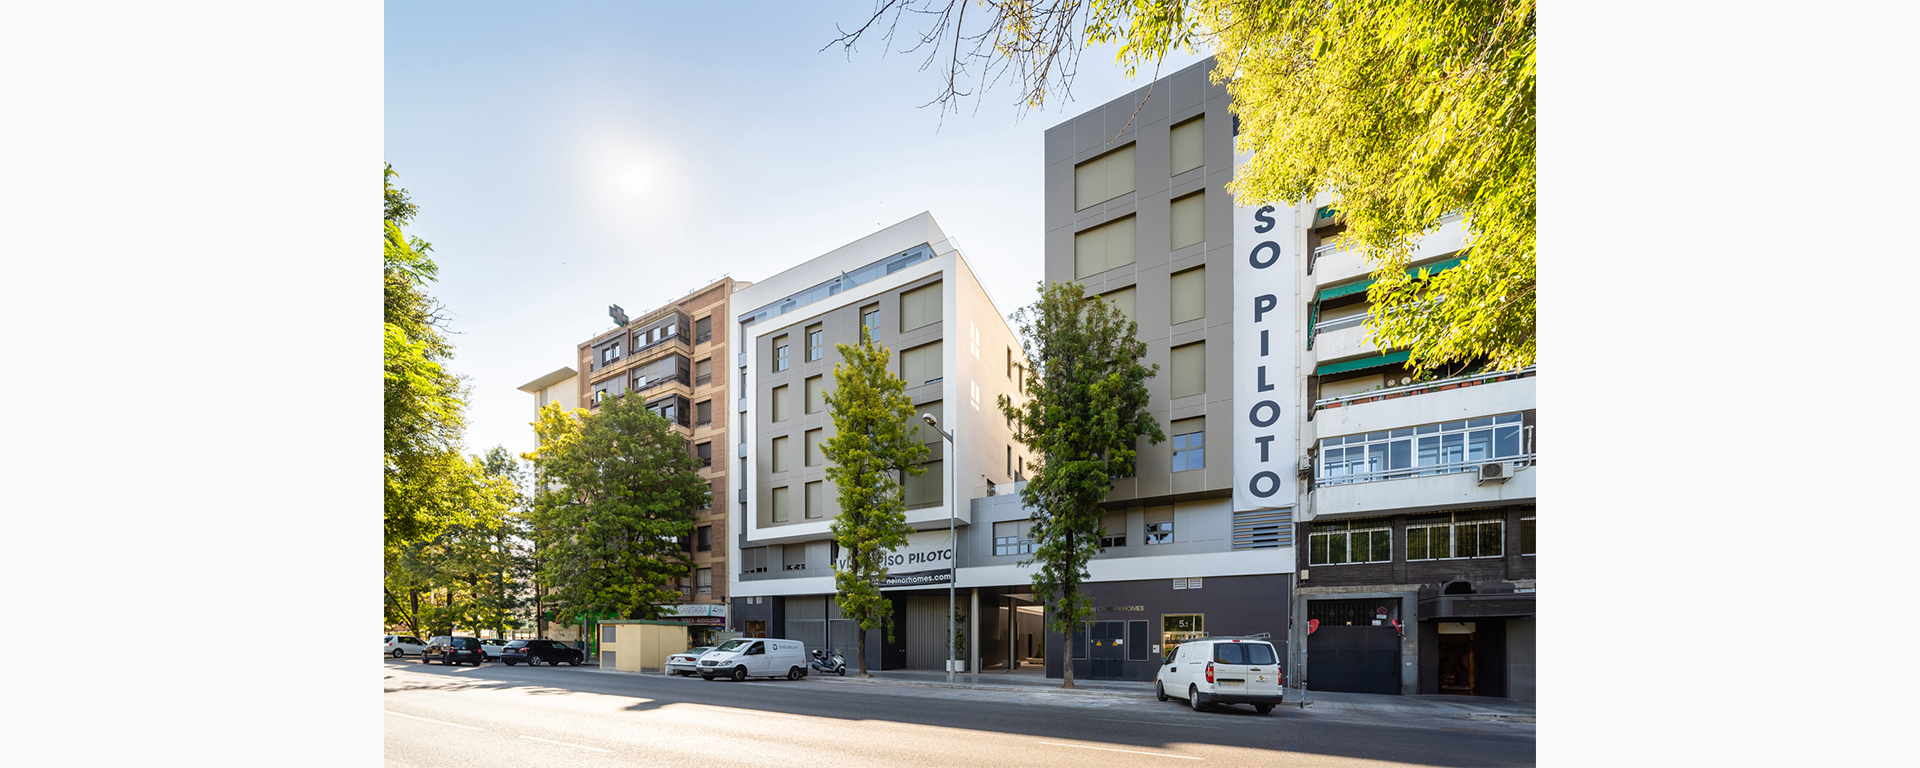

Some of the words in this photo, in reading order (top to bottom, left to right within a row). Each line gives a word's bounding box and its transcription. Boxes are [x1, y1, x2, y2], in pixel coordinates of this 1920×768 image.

[1249, 205, 1281, 270] SO
[1249, 293, 1281, 498] PILOTO
[908, 548, 952, 564] PILOTO
[886, 573, 952, 585] neinorhomes.com
[678, 606, 708, 614] SANITARIA
